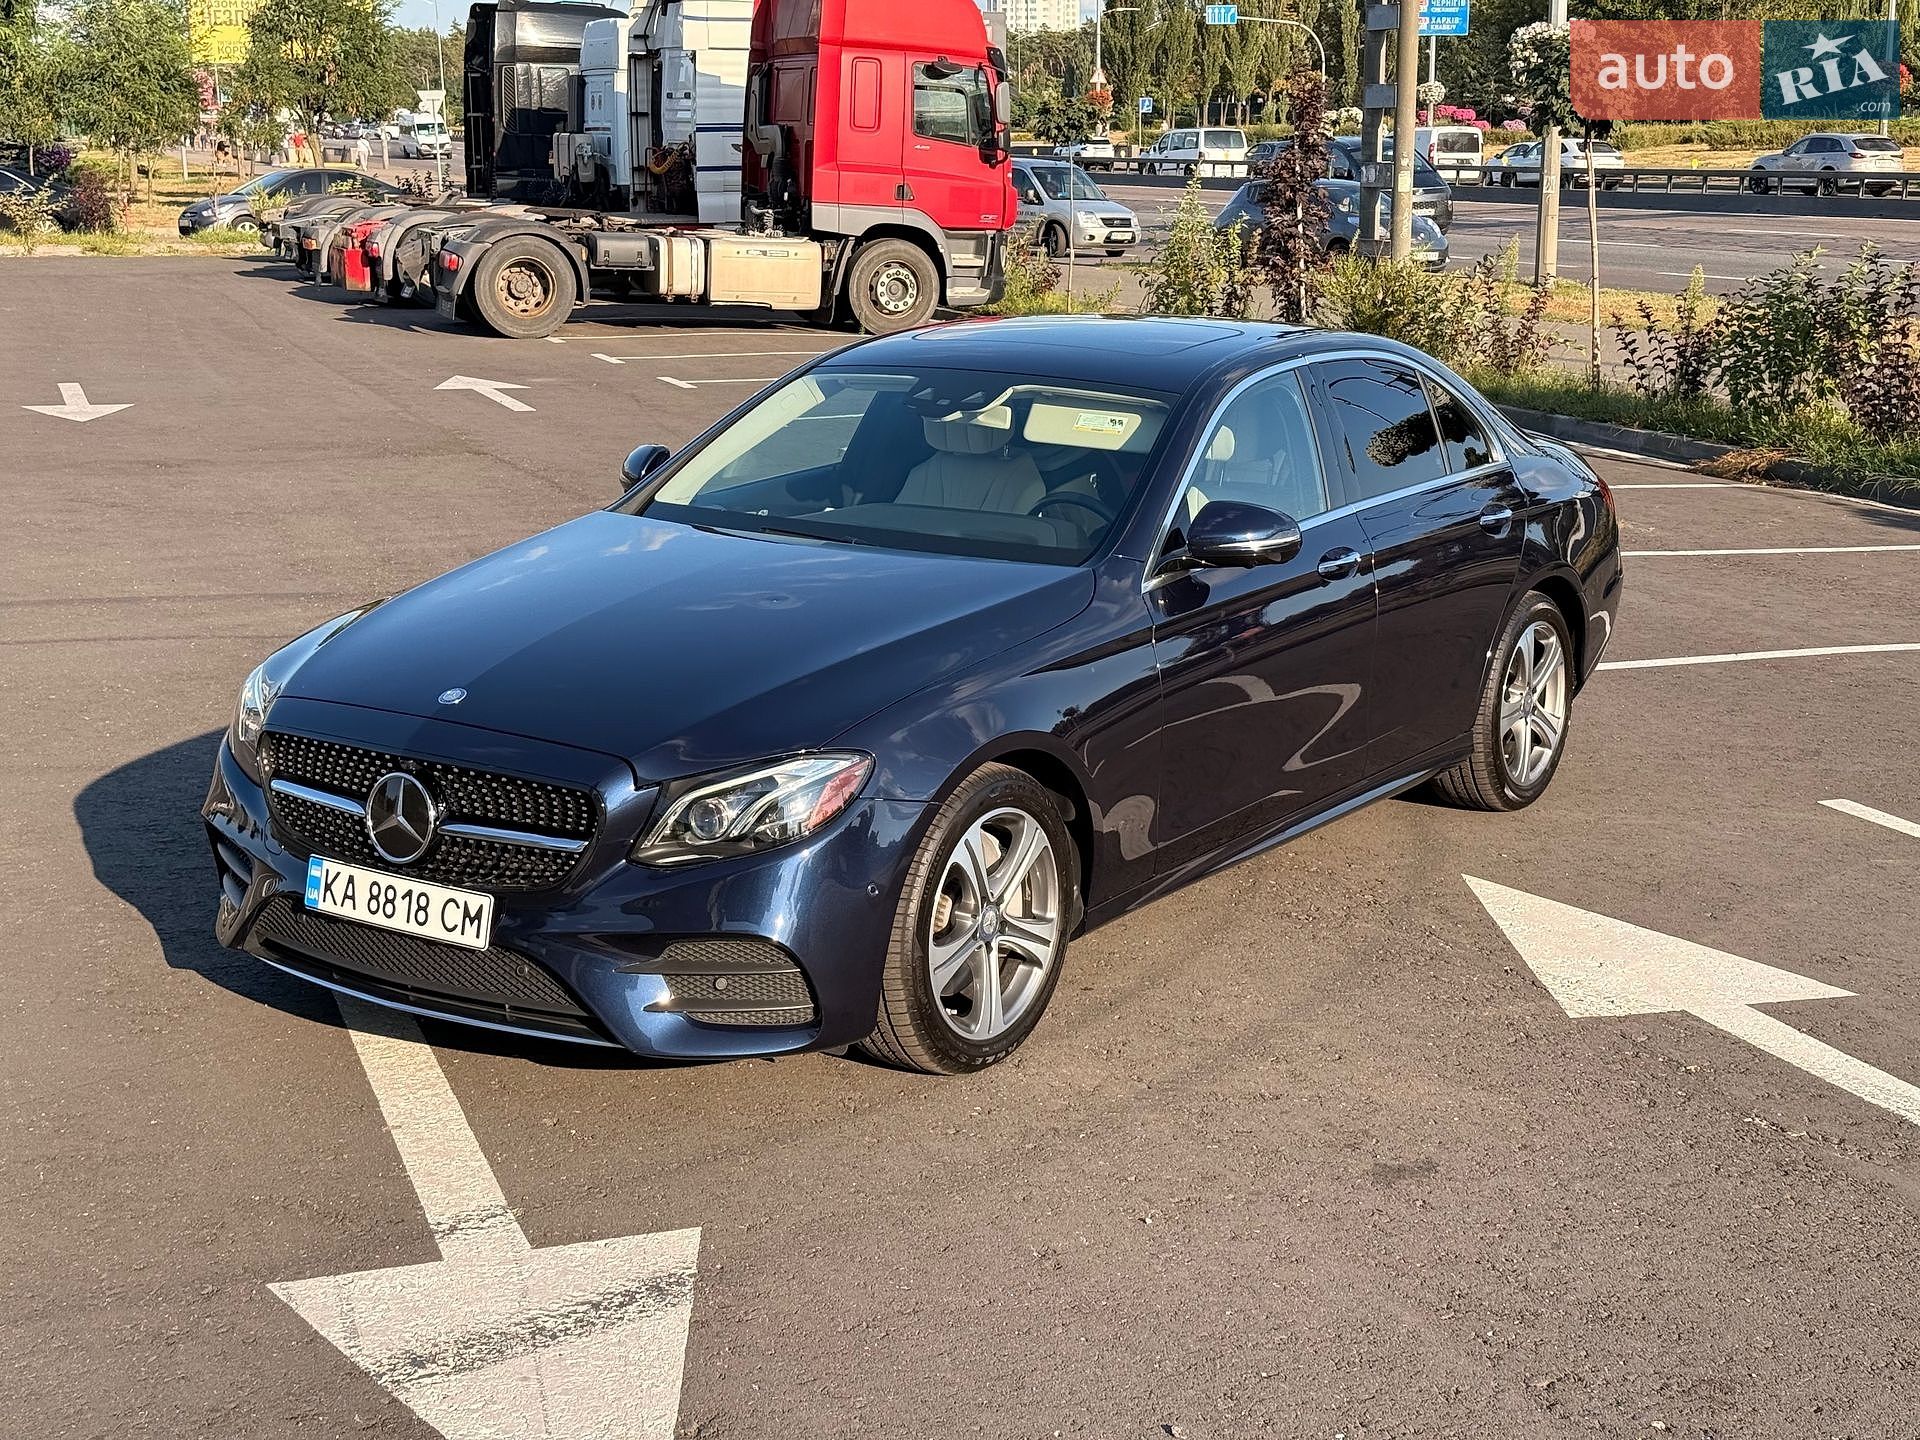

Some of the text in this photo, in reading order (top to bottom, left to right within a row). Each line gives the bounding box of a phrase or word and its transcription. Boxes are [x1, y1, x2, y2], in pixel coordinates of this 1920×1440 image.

[307, 887, 319, 900] UA
[323, 868, 484, 939] KA 8818 CM
